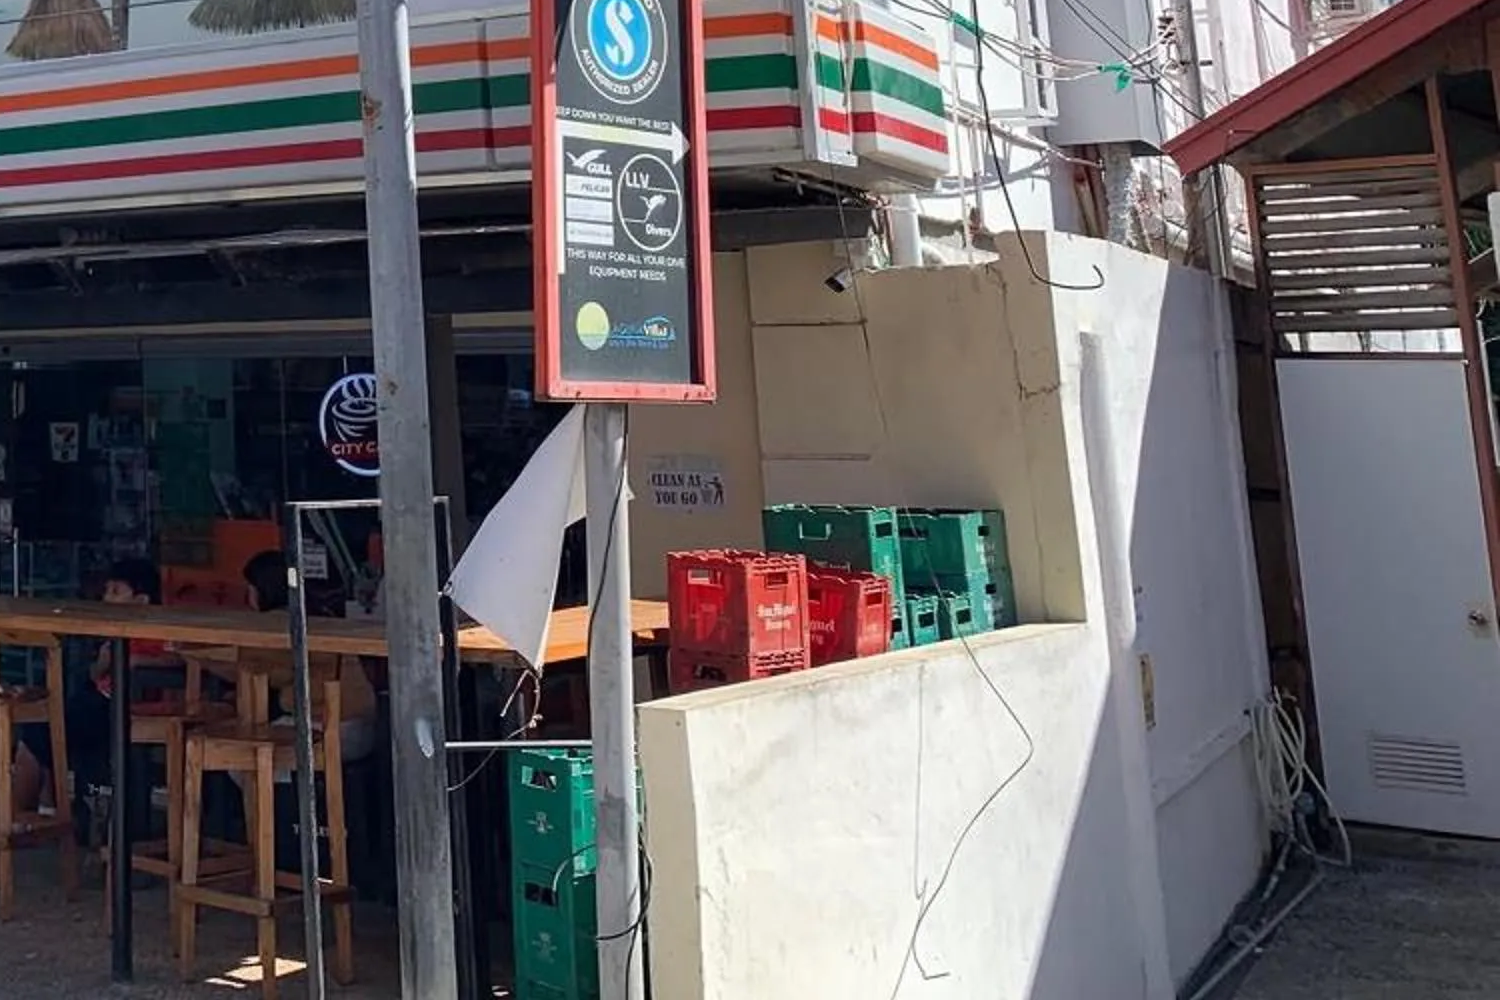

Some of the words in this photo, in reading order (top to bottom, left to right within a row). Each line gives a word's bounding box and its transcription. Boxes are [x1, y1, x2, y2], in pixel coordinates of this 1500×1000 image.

[566, 247, 587, 260] THIS
[331, 443, 363, 456] CITY
[651, 472, 685, 487] CLEAN
[687, 472, 701, 488] AS
[655, 490, 677, 505] YOU
[680, 491, 698, 505] GO
